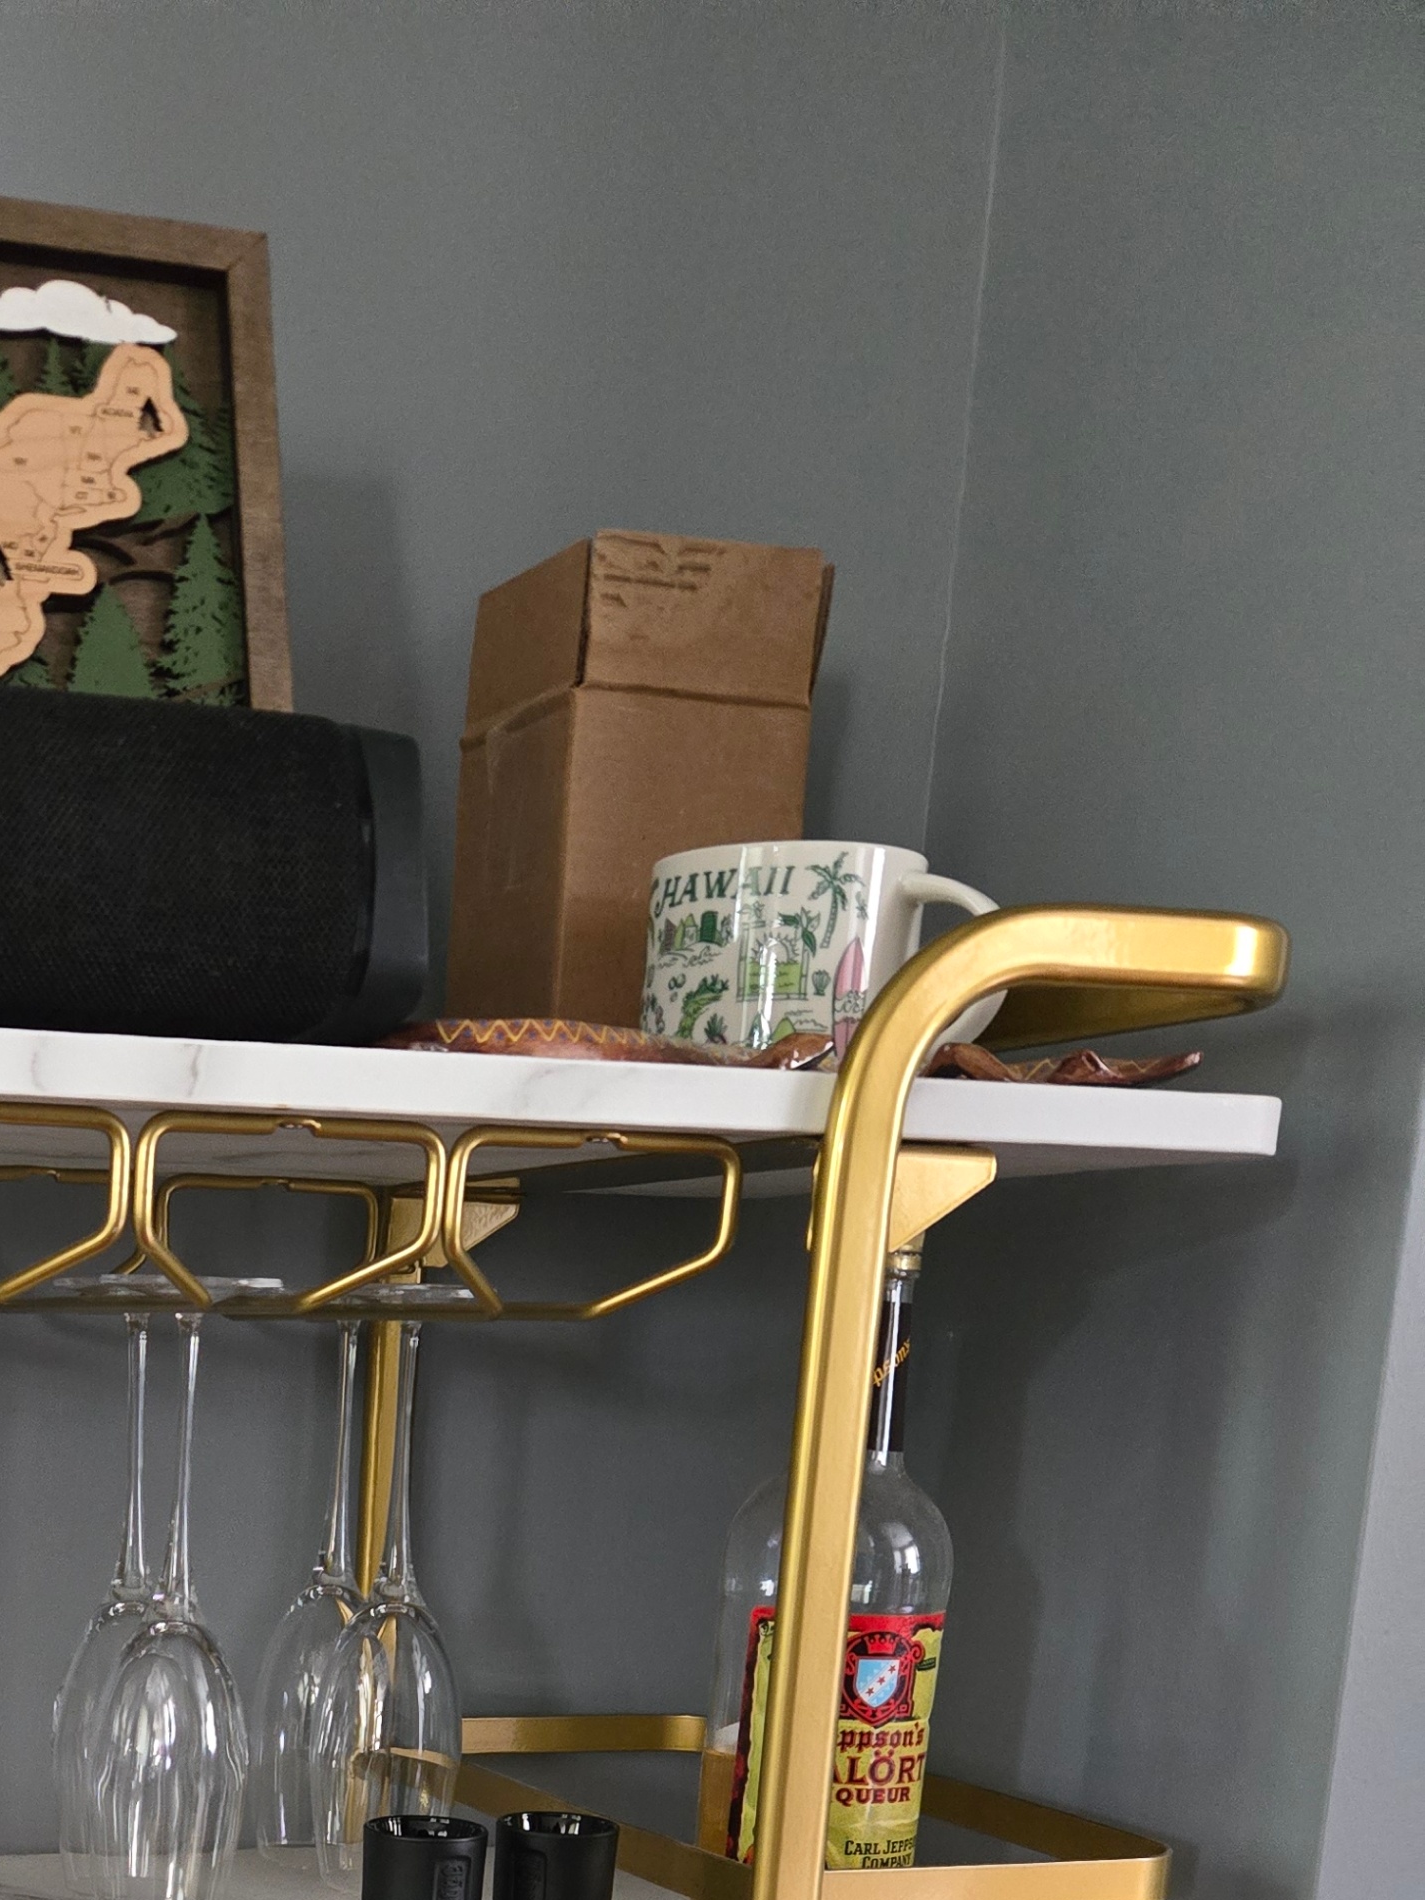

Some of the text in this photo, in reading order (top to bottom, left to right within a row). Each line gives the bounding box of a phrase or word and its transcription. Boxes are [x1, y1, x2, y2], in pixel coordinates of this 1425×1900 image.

[655, 864, 796, 918] HAWAII
[836, 1721, 925, 1753] ppson's
[835, 1786, 911, 1807] QUEUR
[844, 1837, 914, 1856] CARL JEPPS
